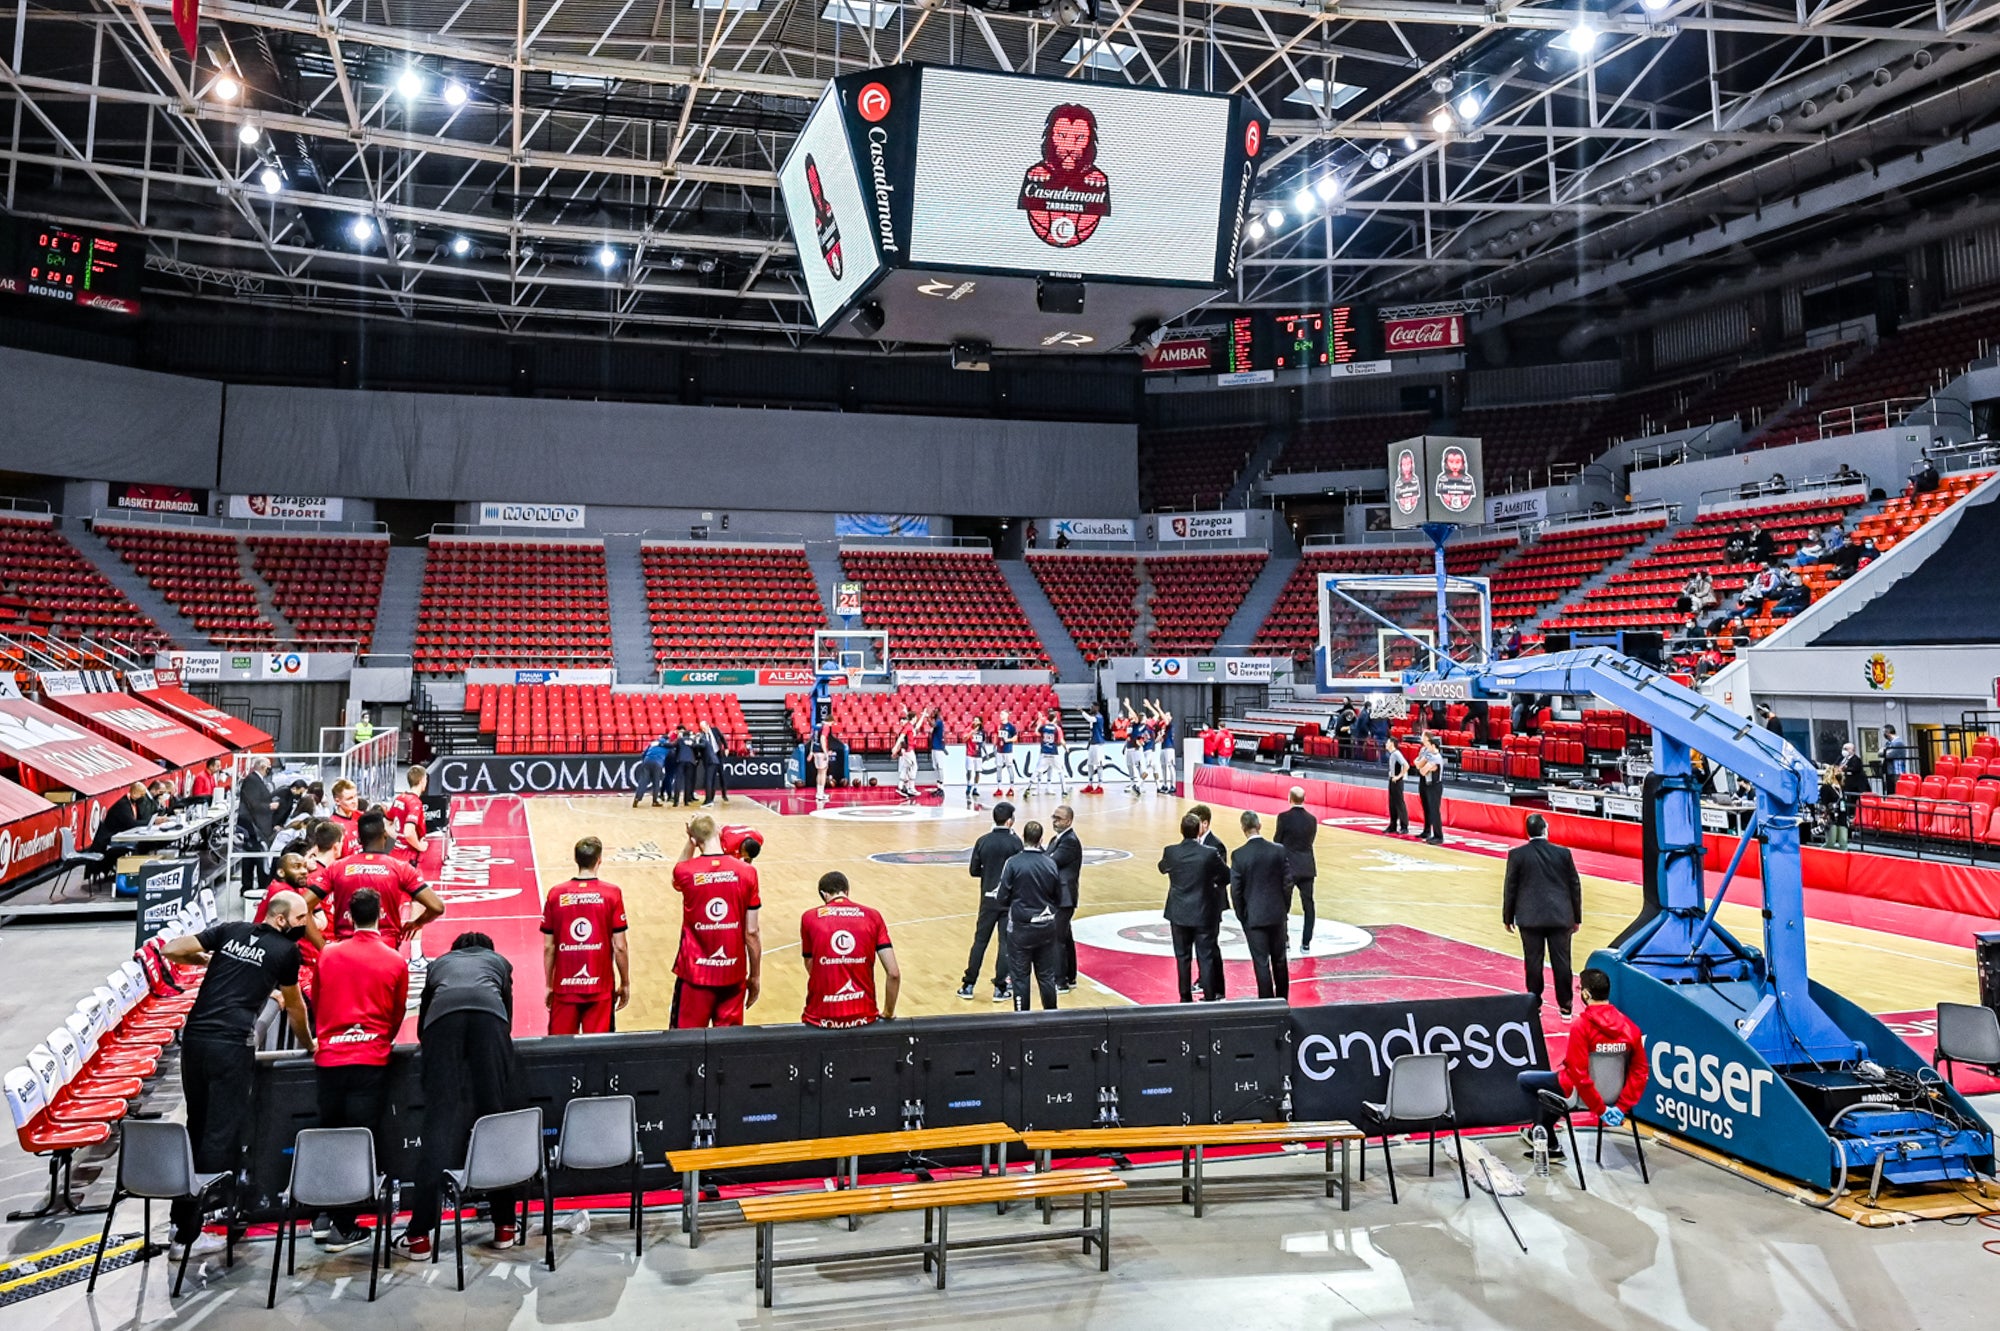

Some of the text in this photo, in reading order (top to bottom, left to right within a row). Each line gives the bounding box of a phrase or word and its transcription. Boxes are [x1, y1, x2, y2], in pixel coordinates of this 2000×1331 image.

[868, 126, 899, 252] Casademont
[1025, 183, 1106, 203] Casademont
[1046, 201, 1083, 212] ZARAGOZA
[1226, 161, 1252, 278] Casademont
[40, 234, 48, 246] 0
[72, 242, 80, 253] 0
[31, 267, 38, 278] 0
[47, 271, 60, 282] 20
[66, 274, 73, 284] 0
[28, 284, 74, 301] MONDO
[1287, 322, 1294, 332] 0
[1314, 320, 1321, 330] 0
[1389, 323, 1445, 345] Coca-Cola
[1159, 347, 1206, 362] AMBAR
[1320, 354, 1327, 362] 0
[1278, 357, 1284, 366] 0
[118, 496, 199, 512] BASKET ZARAGOZA
[272, 495, 326, 506] Zaragoza
[1502, 498, 1538, 515] AMBITEC
[271, 506, 326, 518] DEPORTE
[503, 506, 580, 523] MONDO
[1190, 516, 1232, 529] Zaragoza
[1073, 522, 1129, 536] CaixaBank
[1190, 527, 1232, 538] DEPORTE
[840, 594, 858, 608] 24
[186, 656, 220, 666] Zaragoza
[270, 654, 301, 674] 30
[1240, 661, 1270, 670] Zaragoza
[186, 666, 218, 674] DEPORTE
[1151, 658, 1180, 677] 30
[1240, 668, 1270, 677] DEPORTE
[689, 672, 719, 682] caser
[1418, 682, 1464, 698] endesa
[723, 758, 782, 776] ndesa
[442, 762, 498, 792] GA
[146, 872, 180, 886] FINISHER
[145, 903, 178, 917] FINISHER
[694, 921, 740, 931] Casademont
[222, 938, 266, 963] AMBAR
[559, 942, 602, 952] Casademont
[695, 957, 738, 967] MERCURY
[820, 956, 867, 966] Casademont
[560, 976, 600, 986] MERCURY
[822, 990, 866, 1003] MERCURY
[328, 1032, 379, 1045] MERCURY
[1298, 1013, 1538, 1081] endesa
[1596, 1042, 1627, 1054] SERGIO
[1650, 1040, 1774, 1118] caser
[1234, 1081, 1258, 1092] 1-A-1
[954, 1100, 982, 1108] MONDO
[1046, 1092, 1073, 1104] 1-A-2
[1866, 1093, 1899, 1104] MONDO
[748, 1113, 778, 1122] MONDO
[848, 1106, 877, 1118] 1-A-3
[1655, 1093, 1734, 1141] seguros
